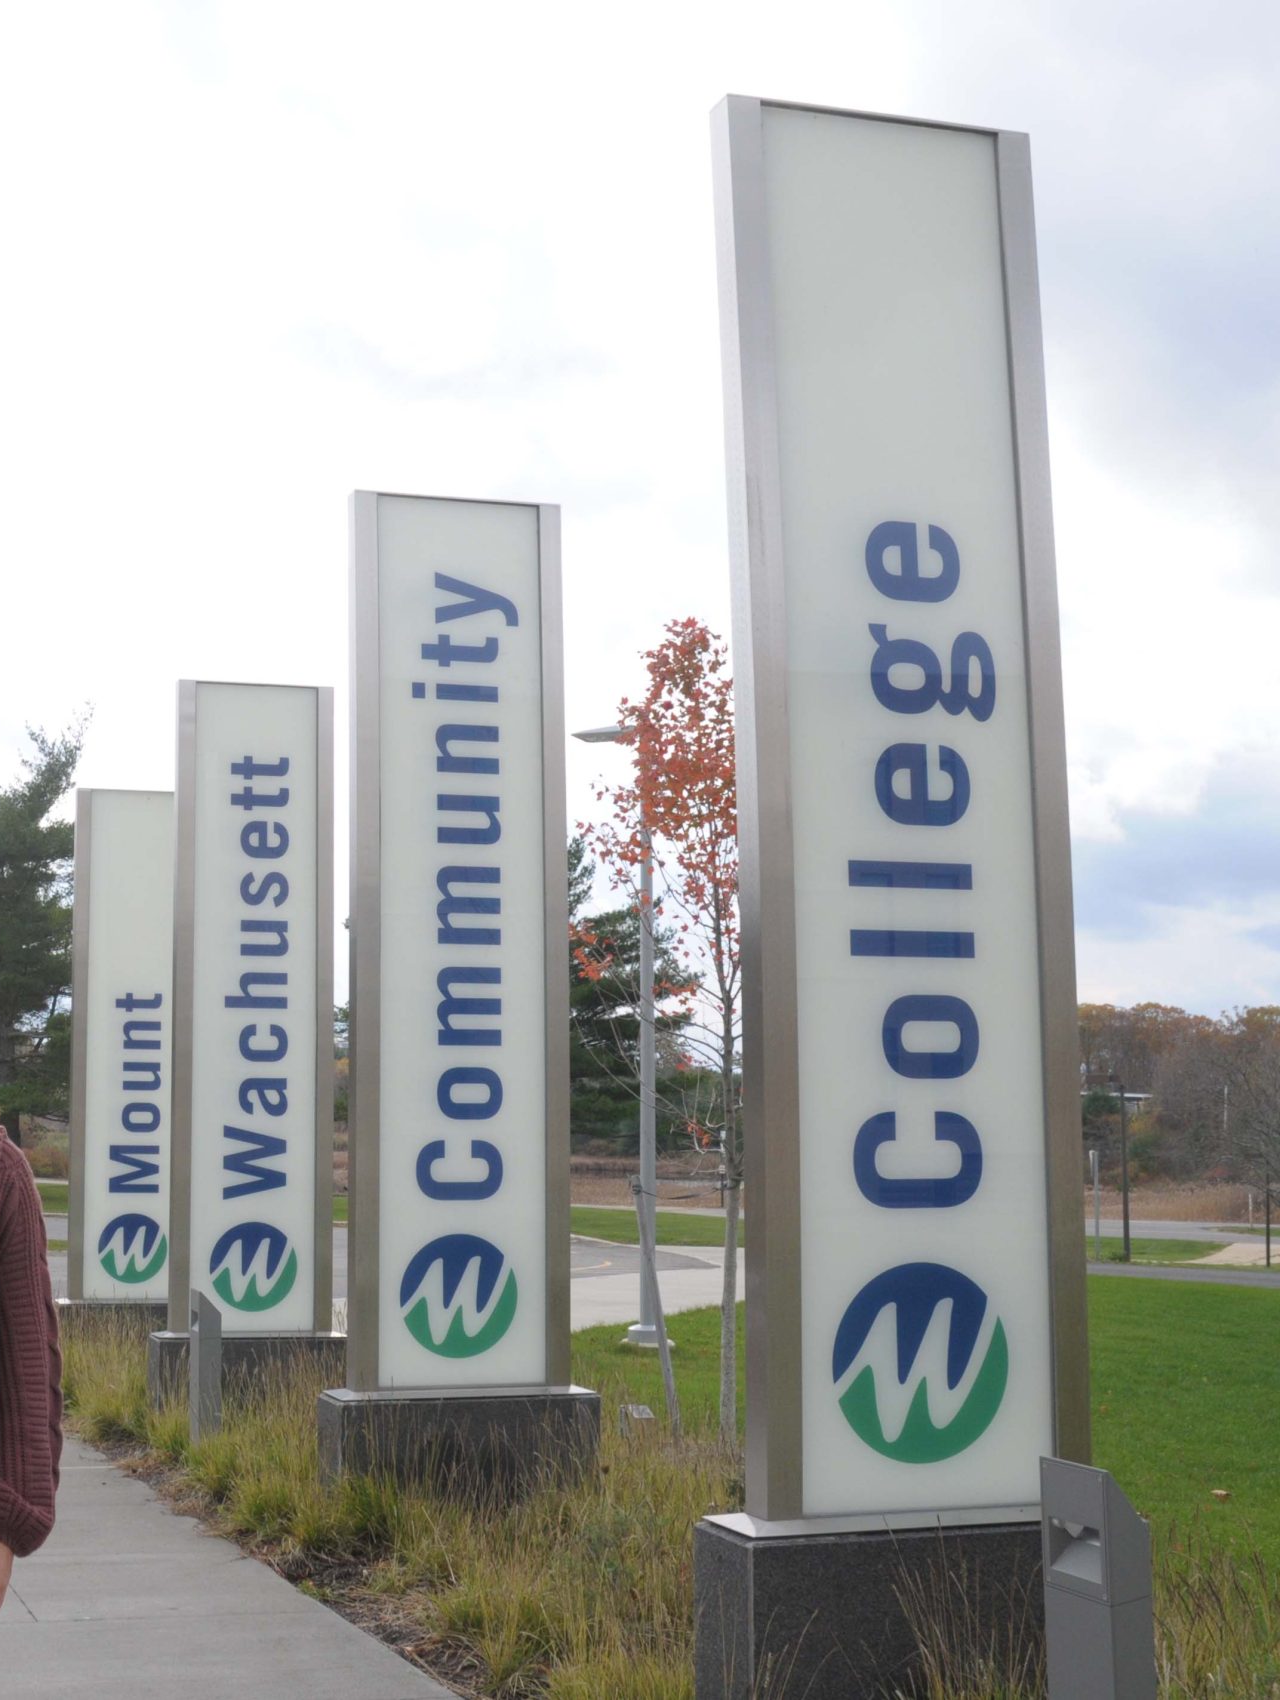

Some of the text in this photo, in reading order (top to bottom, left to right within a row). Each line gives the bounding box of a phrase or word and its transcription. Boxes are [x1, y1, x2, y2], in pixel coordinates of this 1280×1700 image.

[108, 992, 162, 1194] Mount
[223, 755, 290, 1200] Wachusett
[413, 572, 519, 1201] Community
[849, 520, 996, 1209] College
